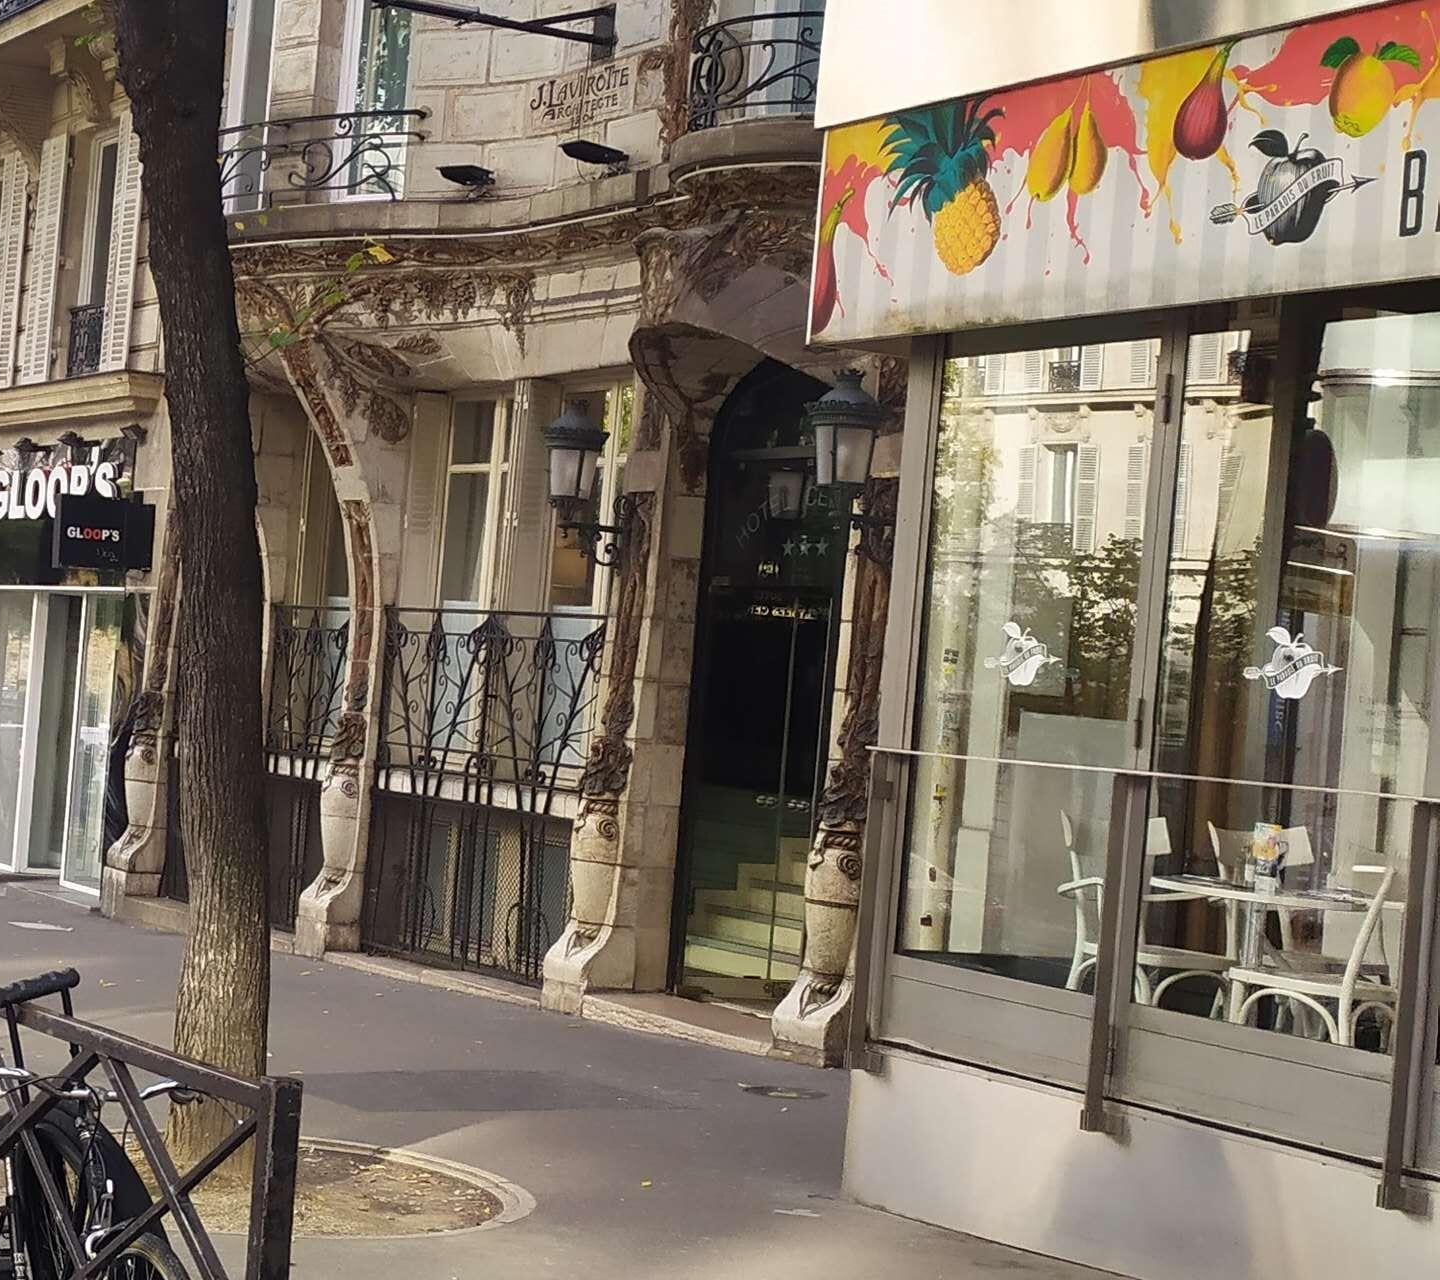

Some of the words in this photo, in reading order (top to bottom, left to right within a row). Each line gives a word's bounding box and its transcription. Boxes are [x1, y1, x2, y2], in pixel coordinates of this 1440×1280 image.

[541, 94, 619, 123] ARCHITECTE
[1254, 213, 1264, 230] LE
[1264, 189, 1297, 222] PARADIS
[1296, 180, 1310, 195] DU
[1311, 162, 1336, 185] FRUIT
[66, 525, 120, 543] GLOOP'S
